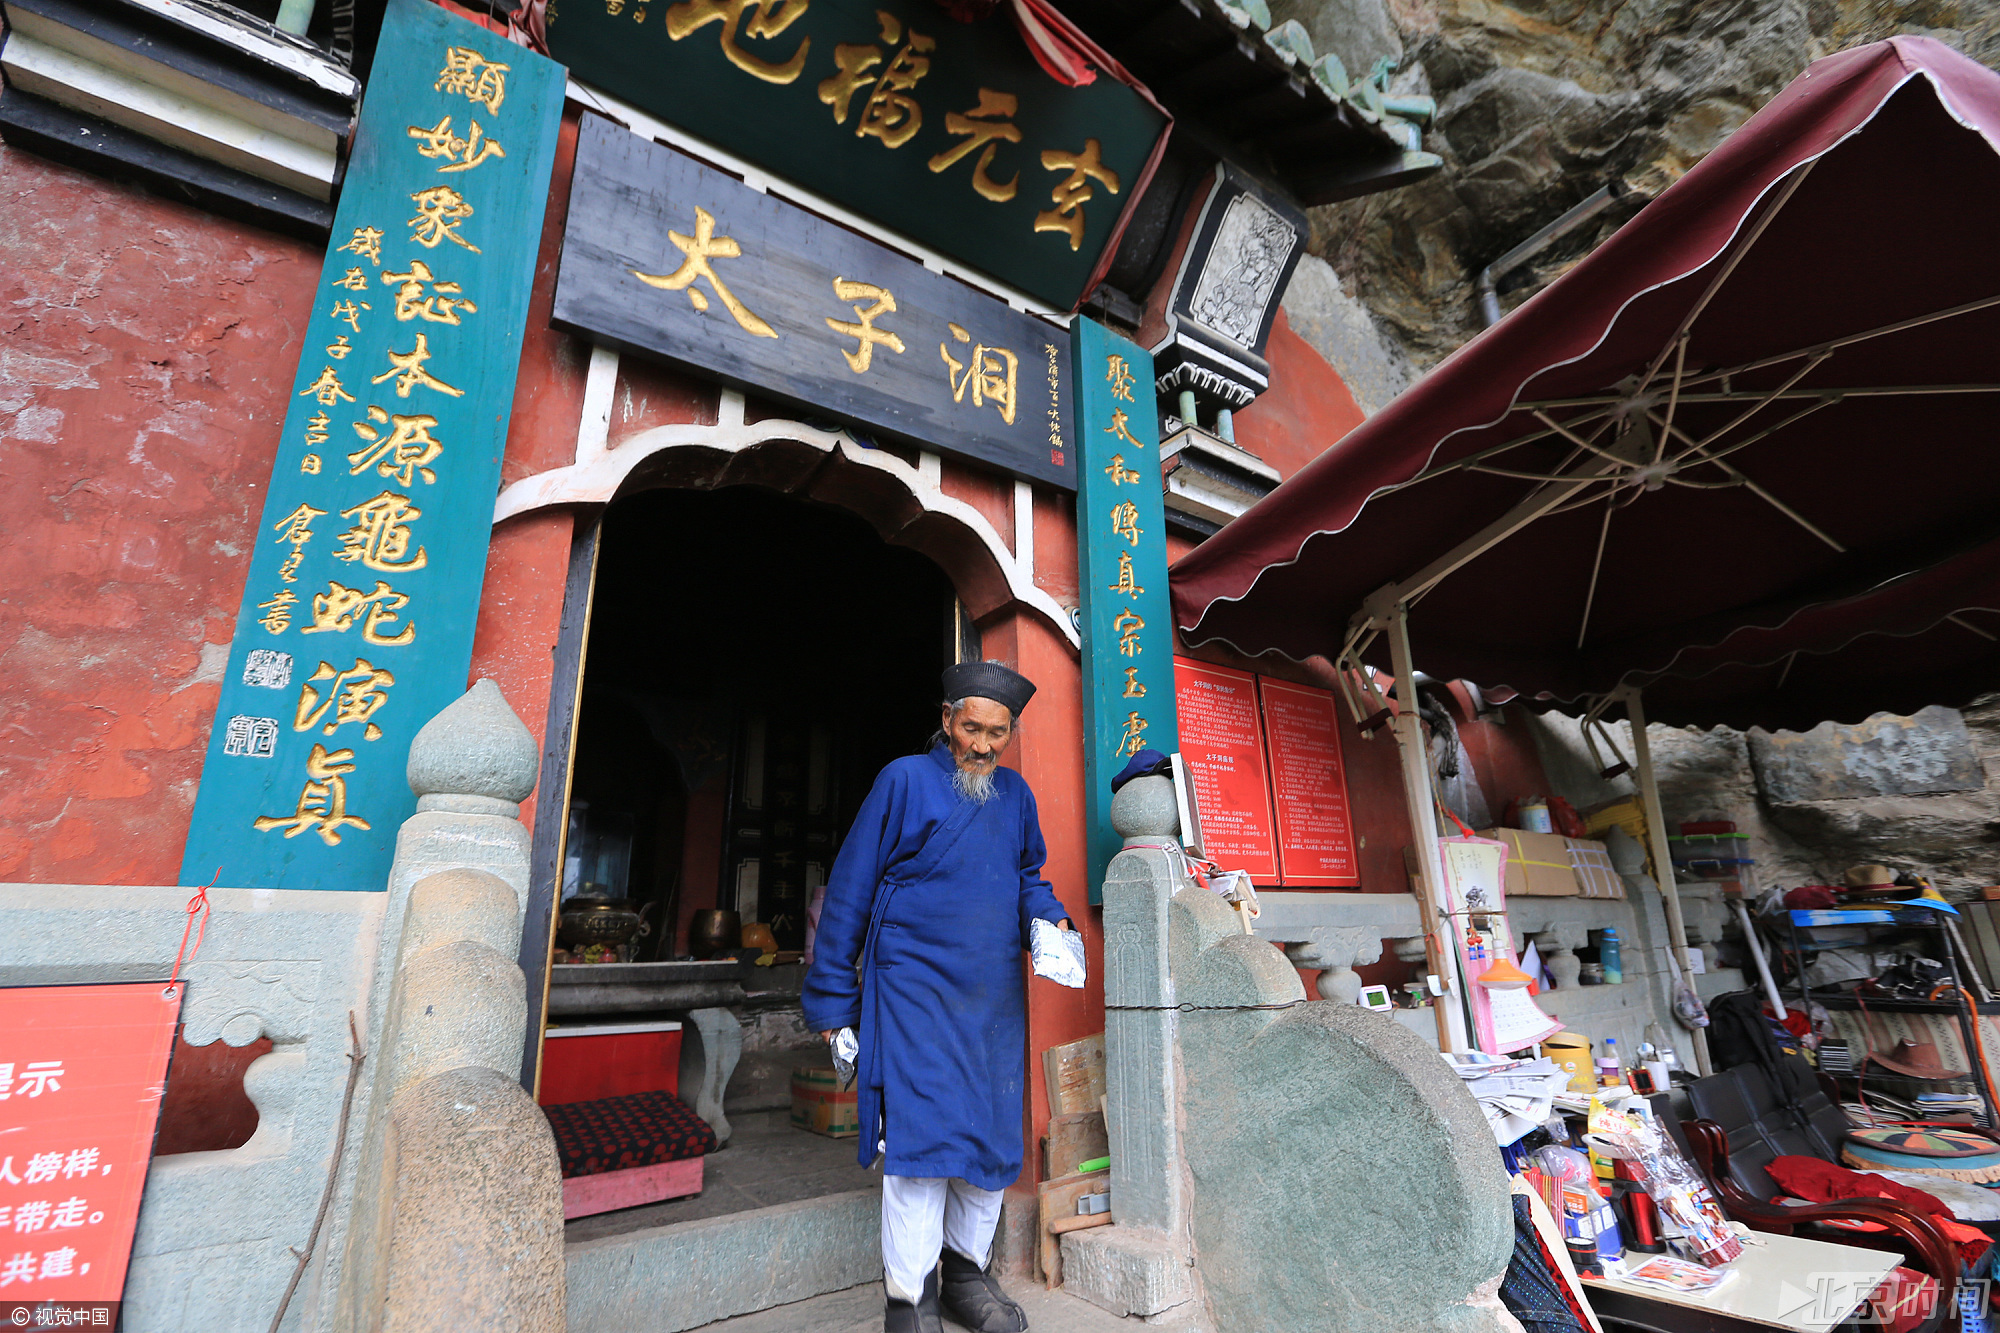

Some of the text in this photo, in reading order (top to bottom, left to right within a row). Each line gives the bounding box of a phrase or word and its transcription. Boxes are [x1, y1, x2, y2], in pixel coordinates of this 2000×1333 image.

[633, 205, 1018, 426] 太子洞
[0, 1196, 105, 1234] 带走。
